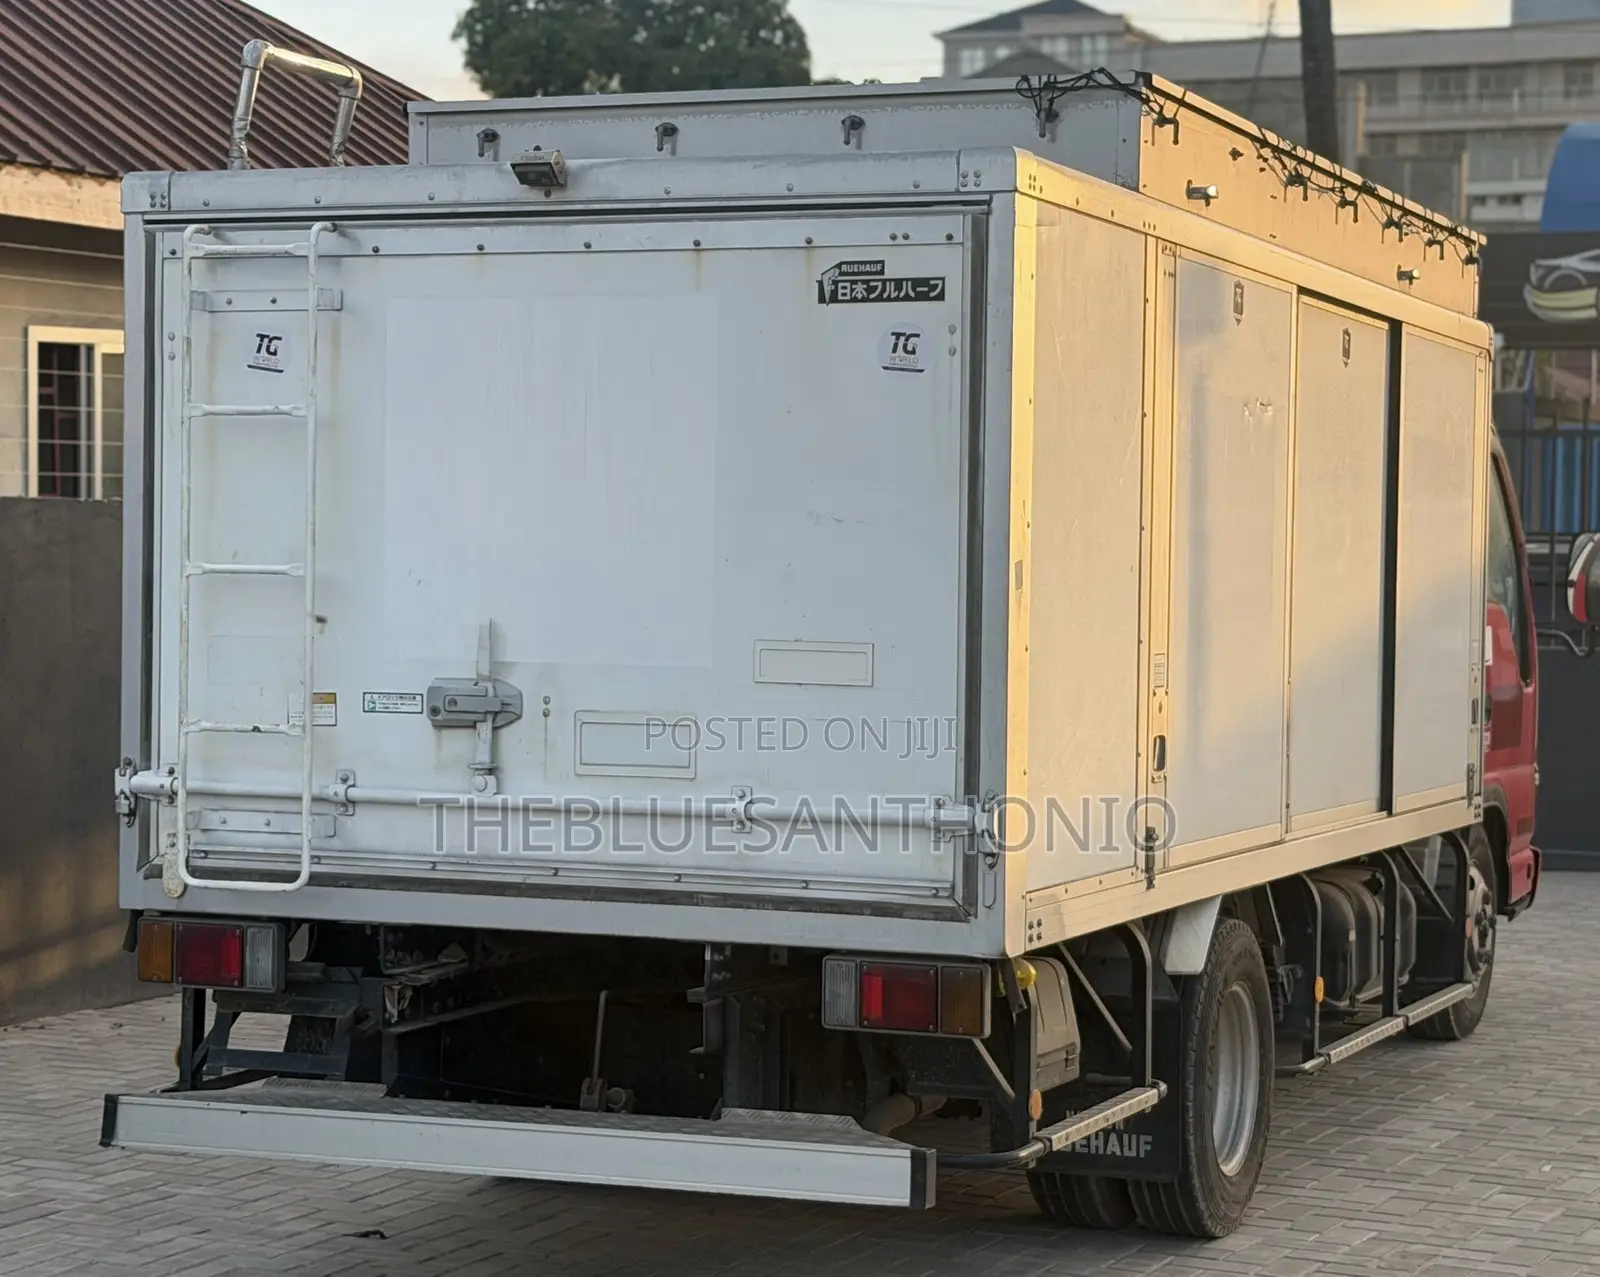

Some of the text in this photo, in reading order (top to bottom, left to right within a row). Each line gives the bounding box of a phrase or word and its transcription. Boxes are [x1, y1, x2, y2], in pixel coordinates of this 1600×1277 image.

[837, 280, 944, 301] 日本フルハーフ
[255, 332, 283, 357] TG
[890, 331, 921, 356] TG
